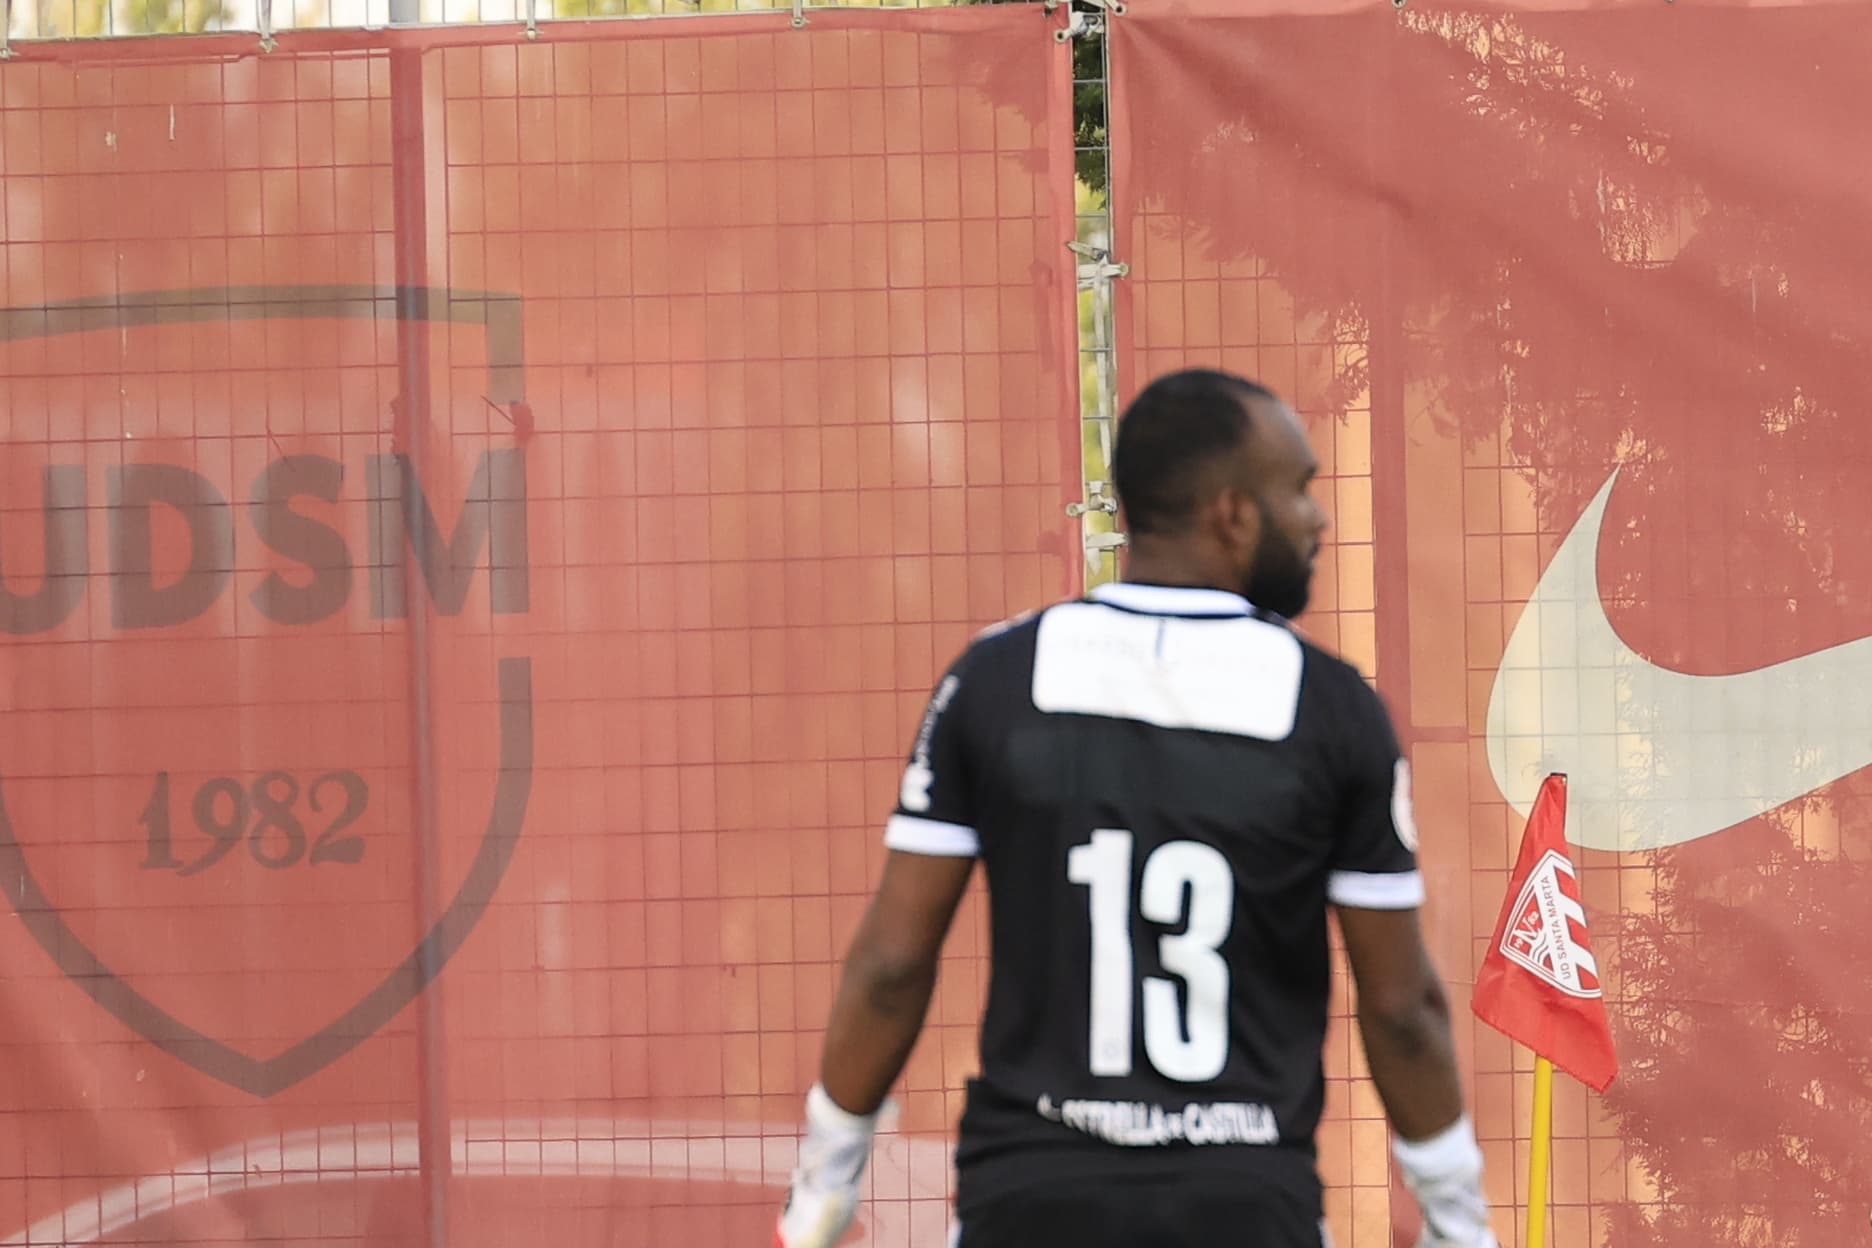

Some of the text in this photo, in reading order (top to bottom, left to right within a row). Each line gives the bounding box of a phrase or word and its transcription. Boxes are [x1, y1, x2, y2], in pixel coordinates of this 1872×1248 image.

[138, 769, 371, 877] 1982
[1067, 828, 1235, 1083] 13
[1541, 875, 1571, 980] UD SANTA MARTA
